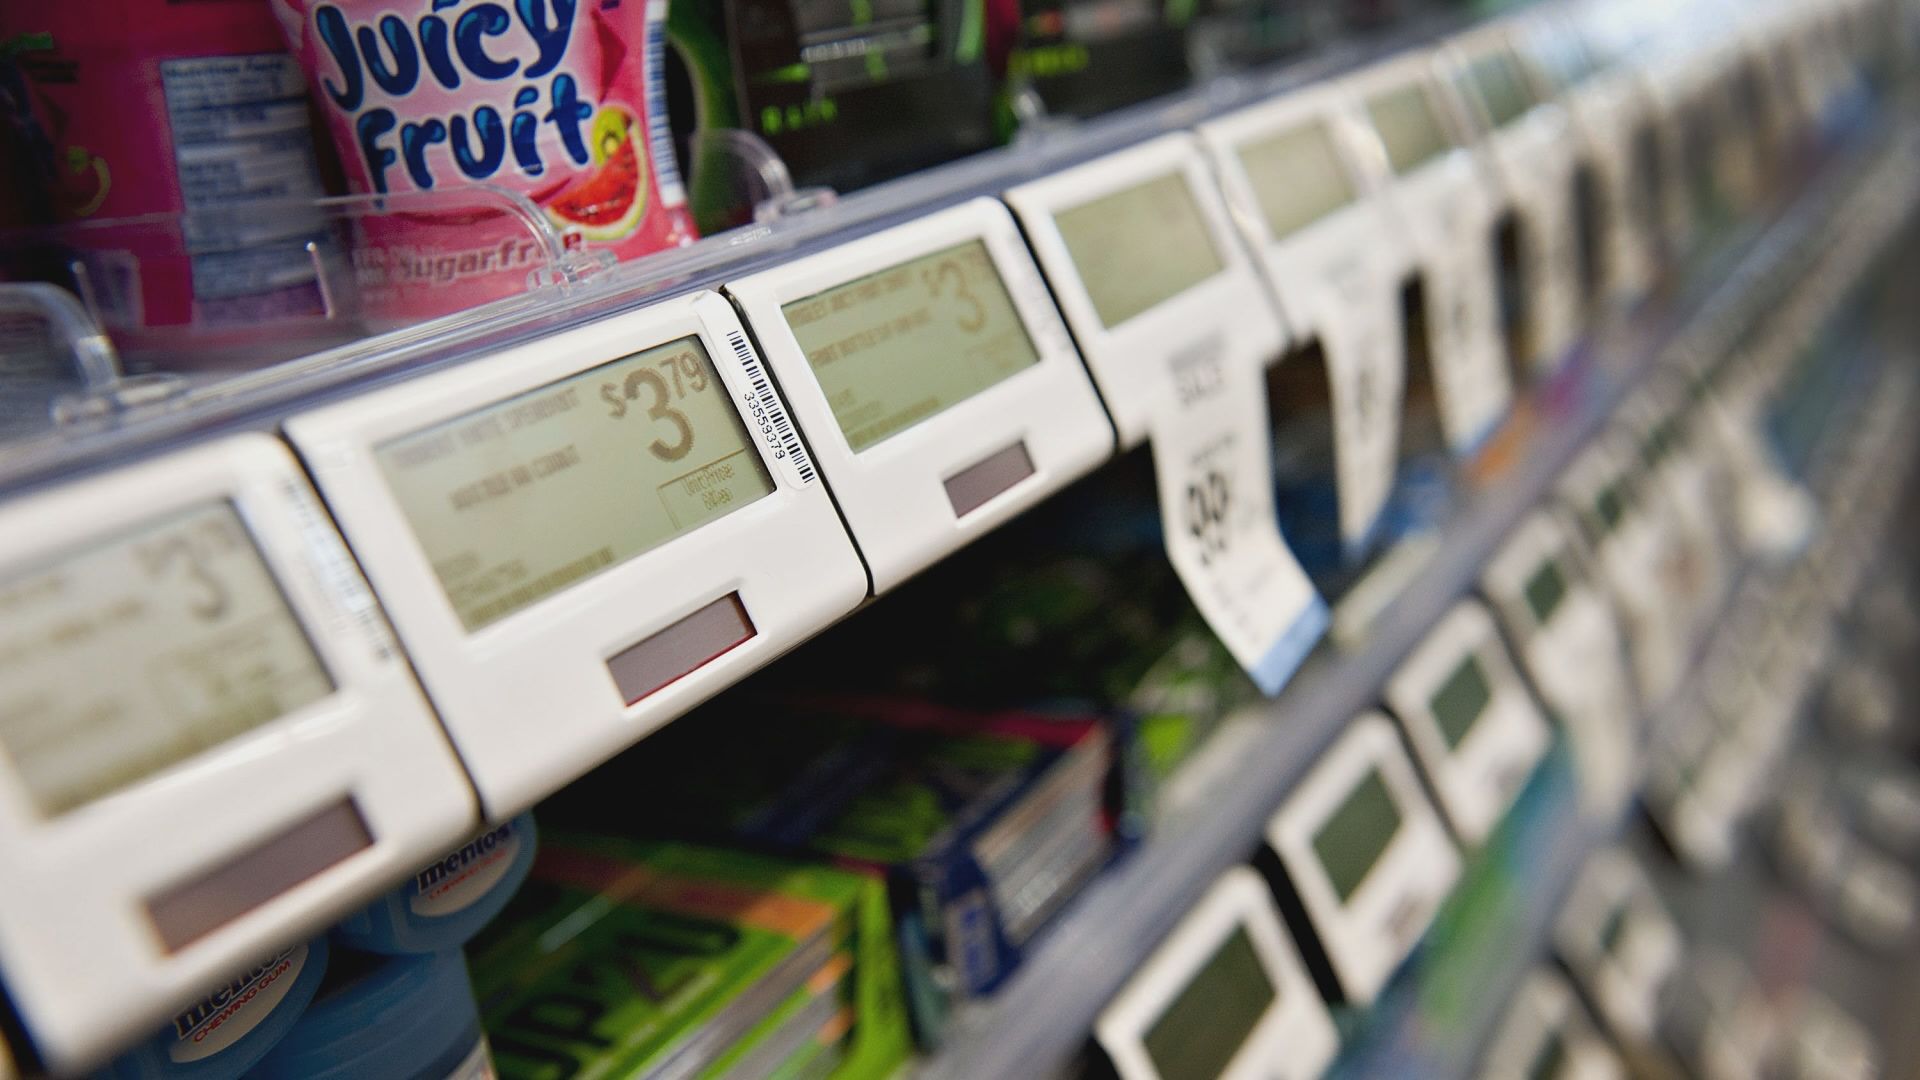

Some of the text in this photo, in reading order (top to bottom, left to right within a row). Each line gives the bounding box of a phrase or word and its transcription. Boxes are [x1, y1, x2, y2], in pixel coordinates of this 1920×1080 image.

[316, 0, 578, 112] Juicy
[744, 391, 786, 460] 33559379
[194, 959, 291, 1042] CHEWING GUM
